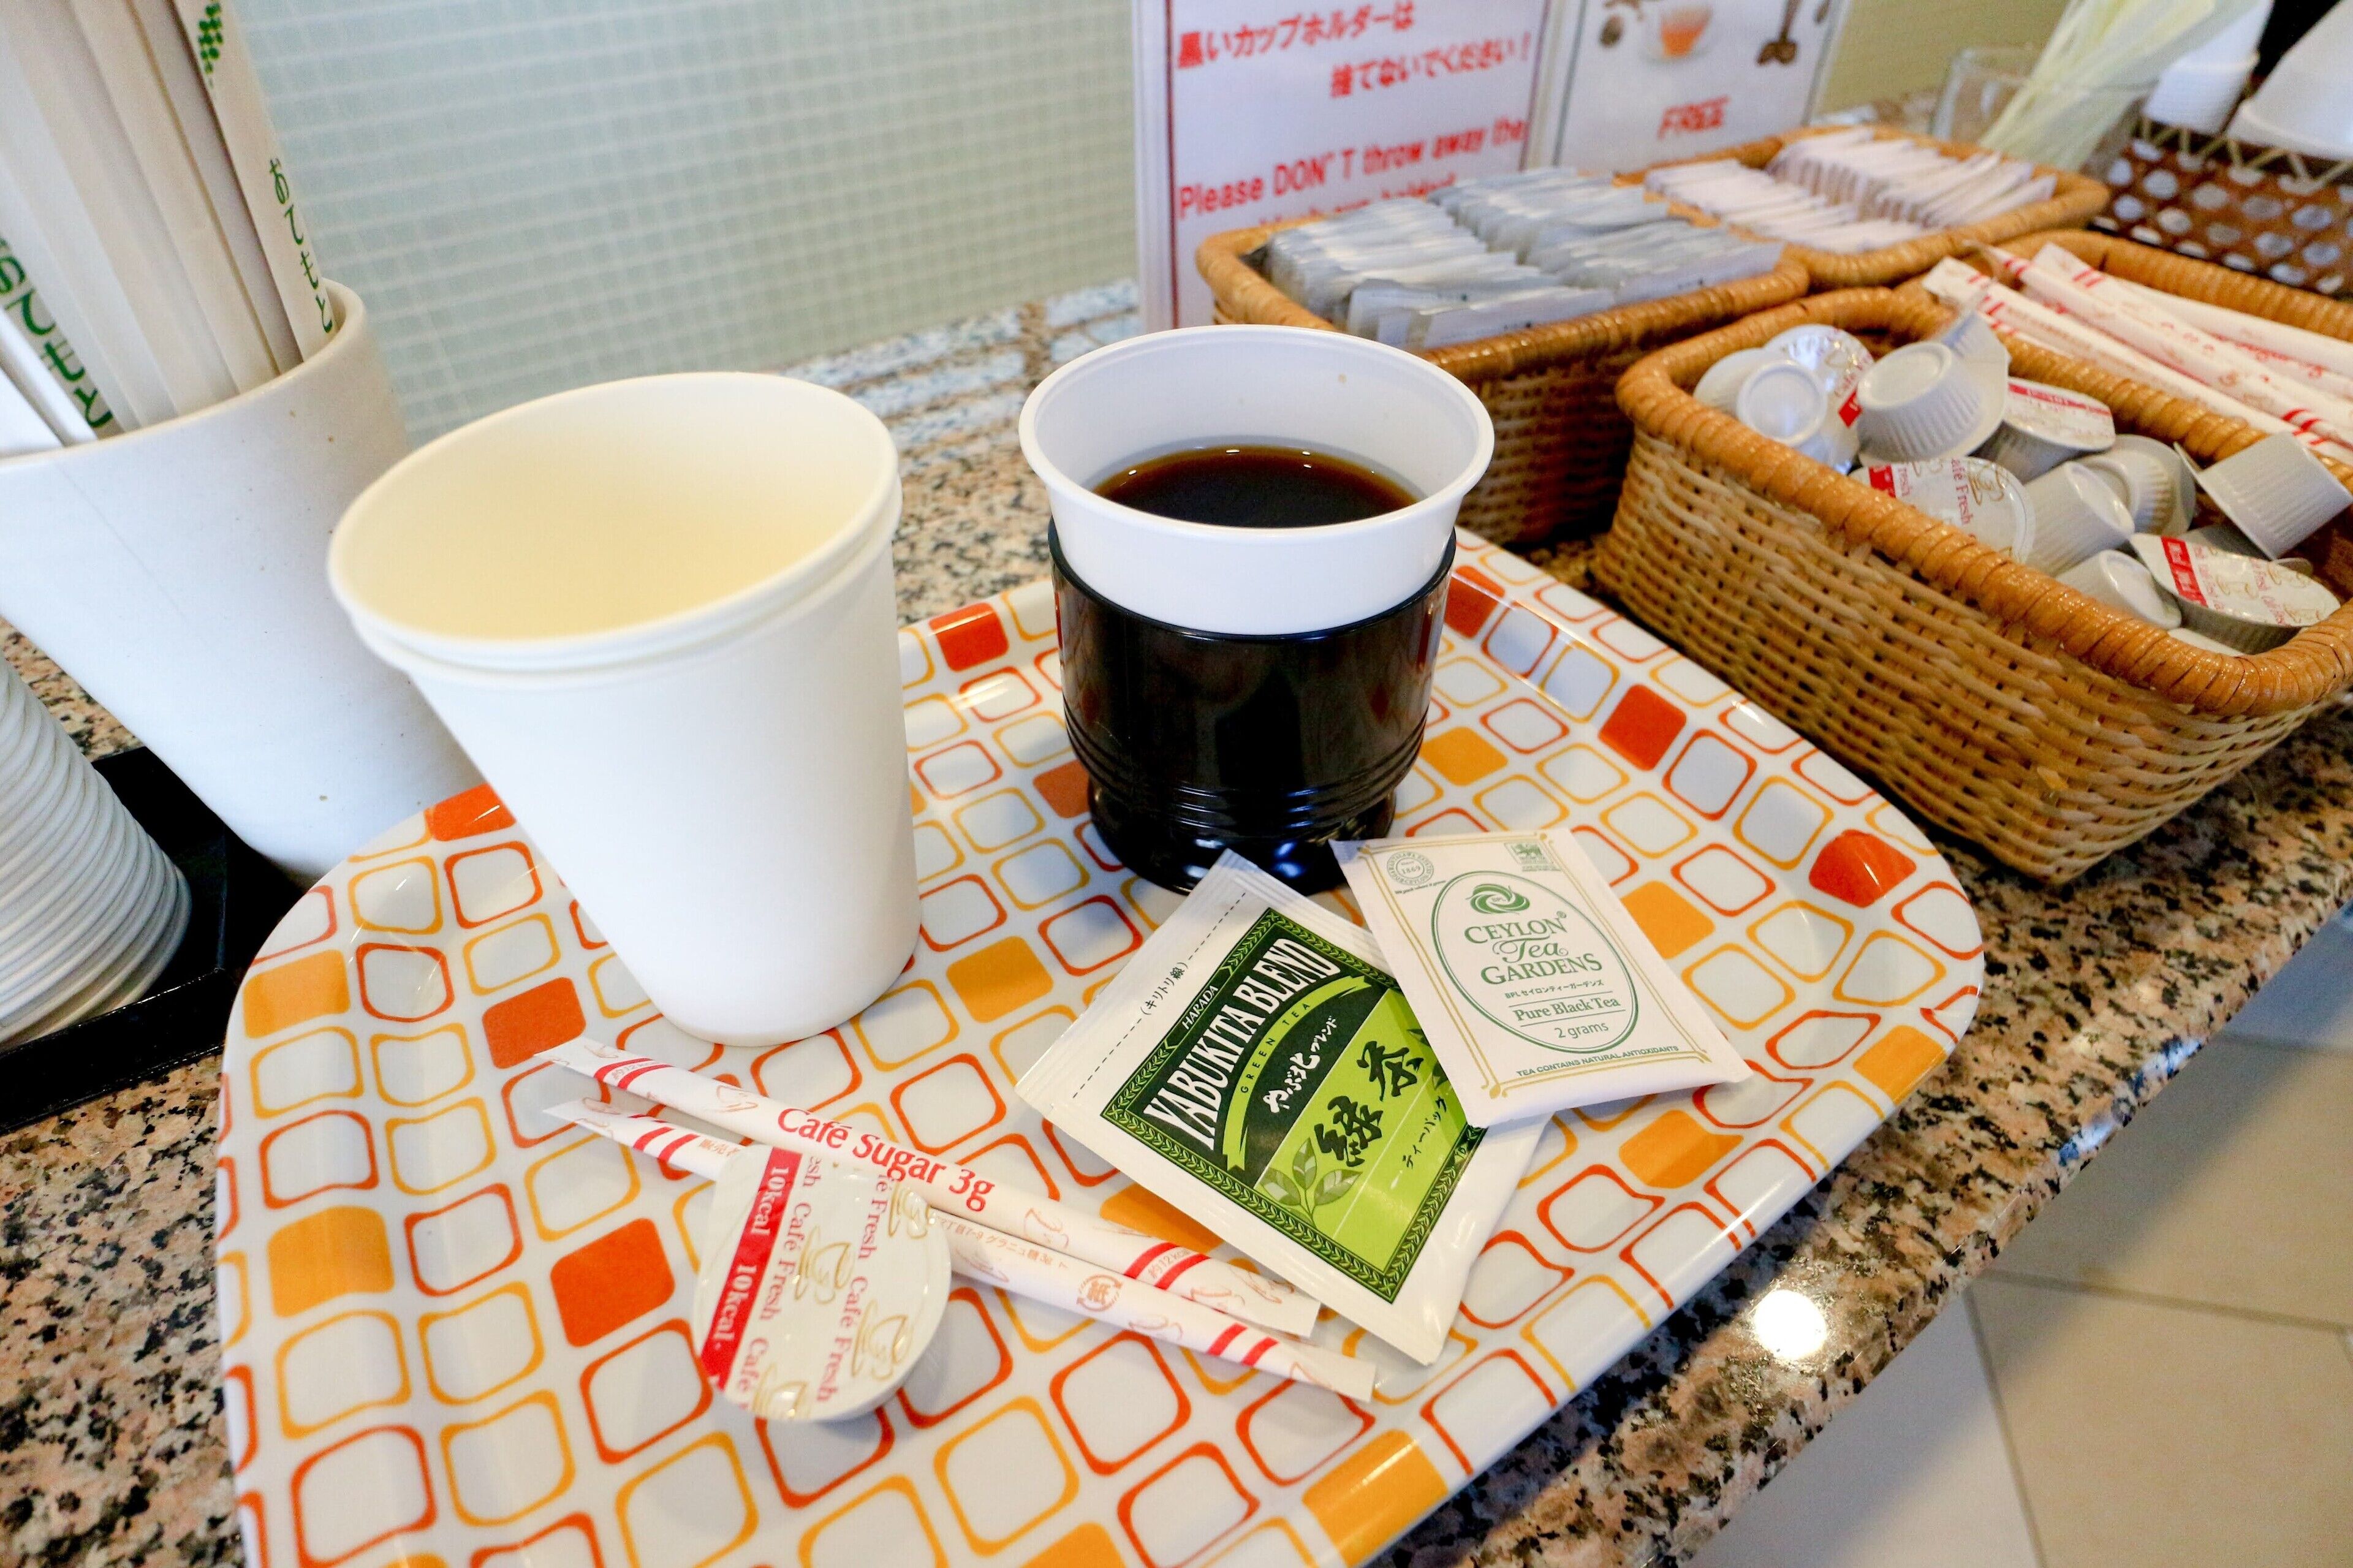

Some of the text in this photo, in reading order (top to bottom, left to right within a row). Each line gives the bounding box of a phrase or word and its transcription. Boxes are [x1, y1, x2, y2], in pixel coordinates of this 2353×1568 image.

[1179, 177, 1264, 219] Please
[1362, 139, 1426, 175] throw
[1432, 128, 1486, 159] away
[1491, 119, 1527, 146] the
[270, 157, 333, 334] おてもと
[1898, 467, 1912, 497] resh
[1464, 918, 1568, 944] CEYLON
[1492, 934, 1569, 963] Tea
[1480, 953, 1603, 985] GARDENS
[1181, 984, 1219, 1030] HARADA
[1512, 996, 1621, 1021] Pure Black Tea
[1555, 1022, 1609, 1039] 2 grams
[1143, 938, 1341, 1151] YABUKITA BLEND
[1240, 1002, 1310, 1094] GREEN TEA
[1516, 1045, 1679, 1077] TEA CONTAINS NATURAL ANTIOXIDANTS
[777, 1107, 995, 1213] Café Sugar 3g
[713, 1165, 790, 1343] 10kcal 10kcal
[858, 1198, 888, 1260] Fresh
[759, 1259, 797, 1321] Fresh
[839, 1276, 868, 1328] Café
[816, 1336, 852, 1403] Fresh
